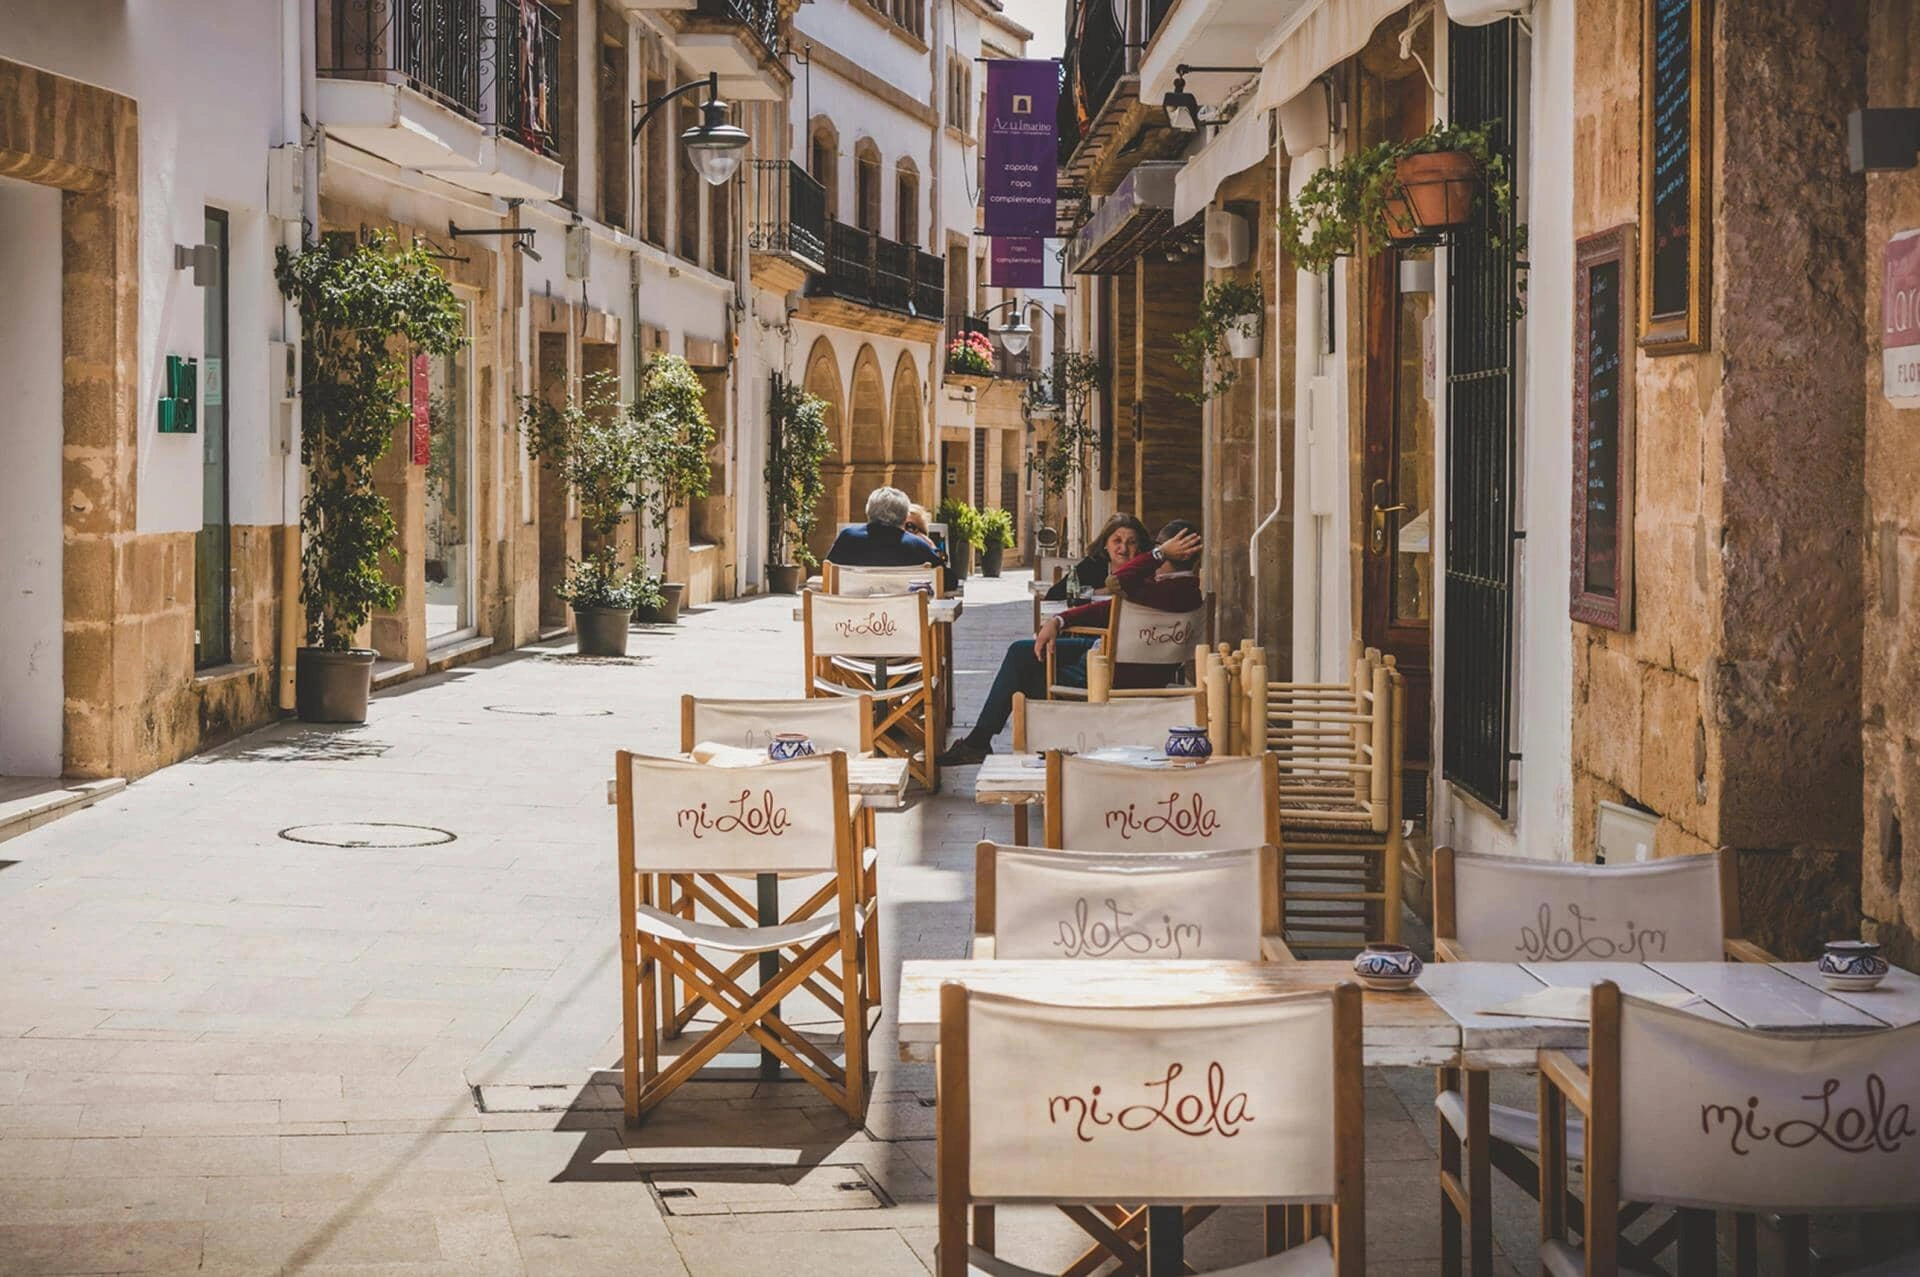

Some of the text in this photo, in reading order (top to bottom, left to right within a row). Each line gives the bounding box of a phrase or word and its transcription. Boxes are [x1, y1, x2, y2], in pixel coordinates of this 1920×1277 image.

[1004, 163, 1039, 172] zapatos
[1010, 180, 1032, 188] ropa
[990, 195, 1052, 204] complementos
[835, 611, 897, 638] mi Lola
[678, 789, 791, 838] mi Lola
[1105, 793, 1221, 840] mi Lola
[1049, 1061, 1254, 1142] mi Lola
[1702, 1073, 1916, 1155] mi Lola
